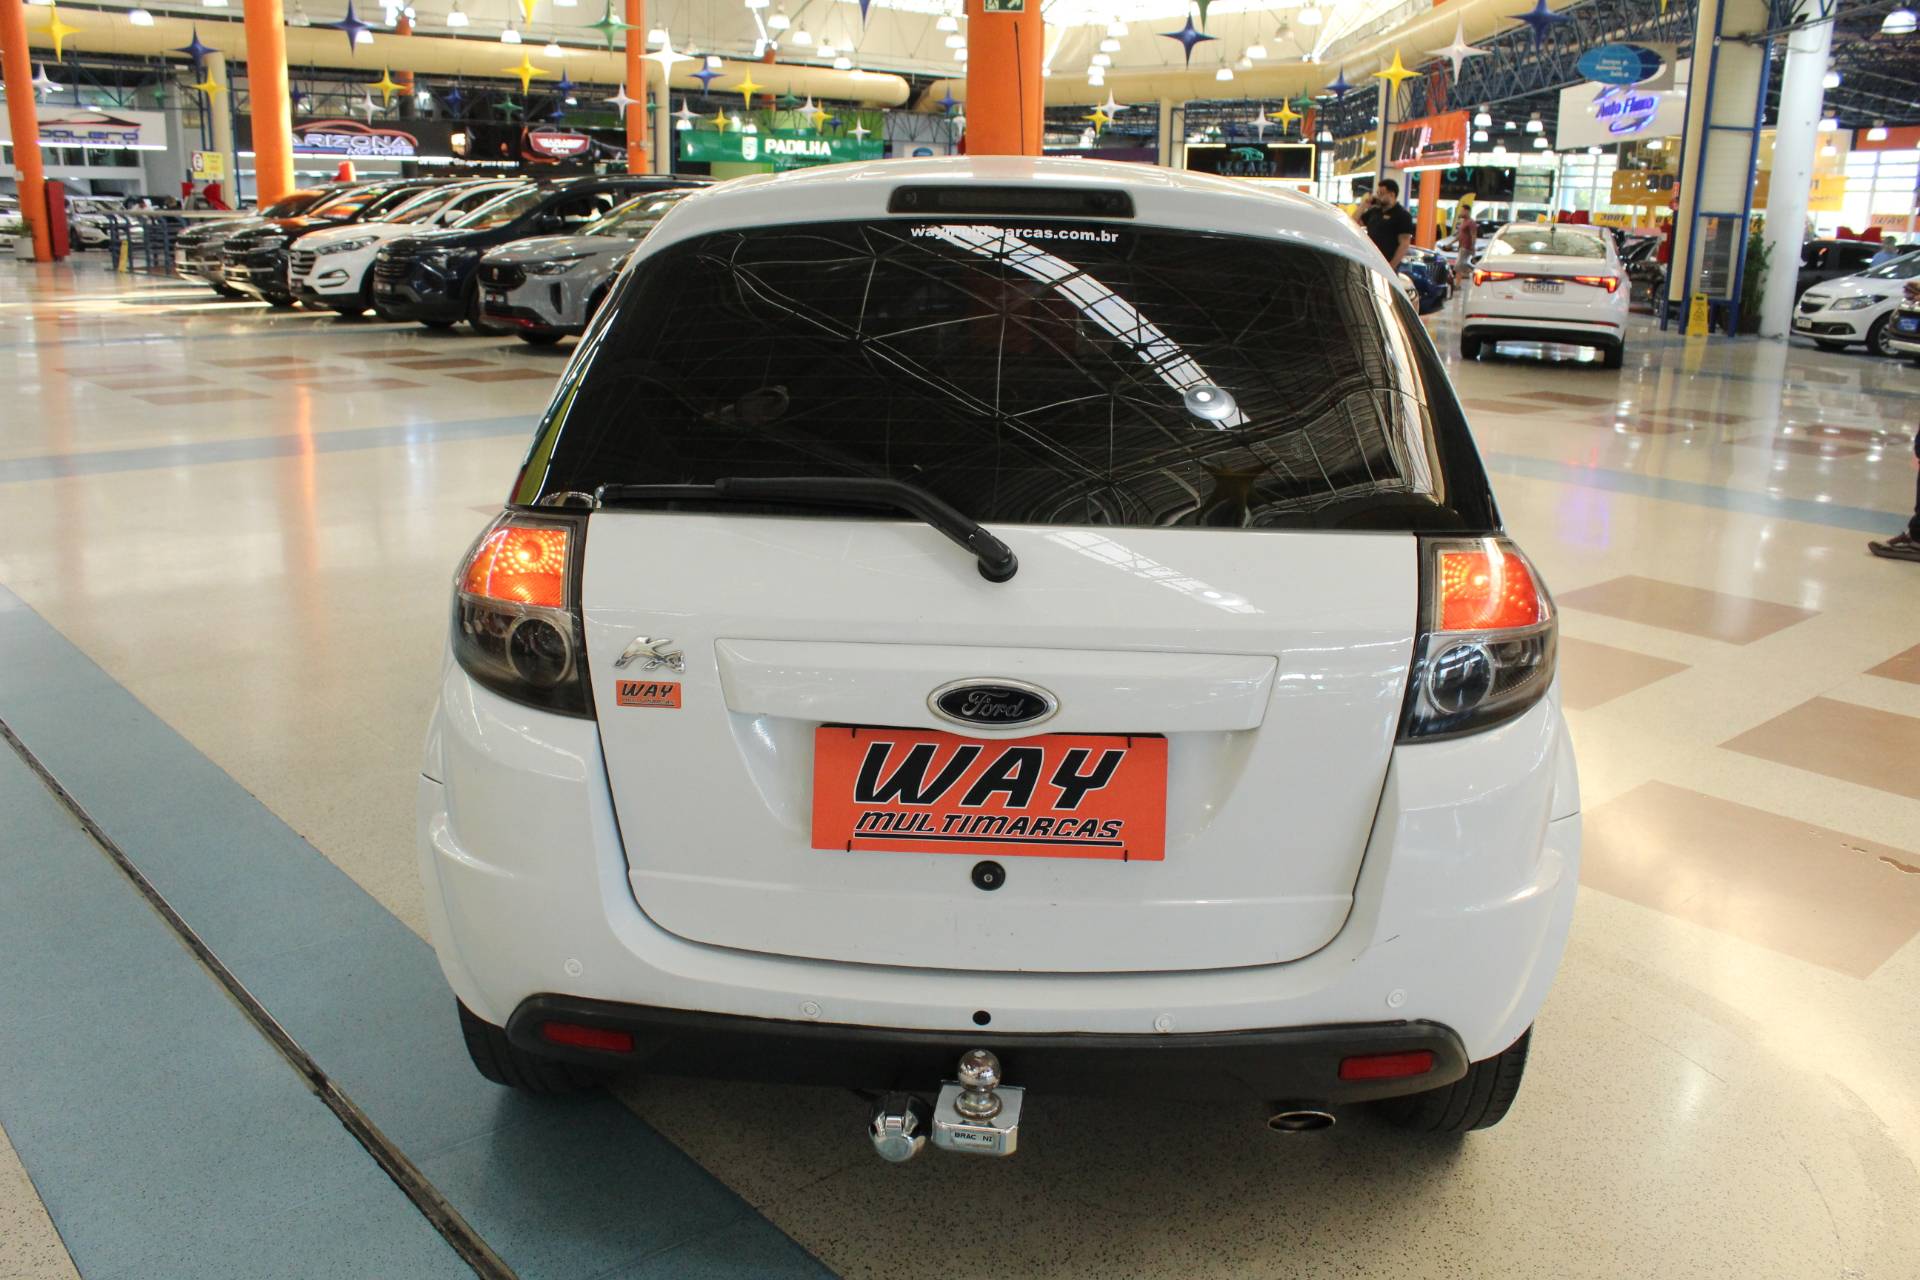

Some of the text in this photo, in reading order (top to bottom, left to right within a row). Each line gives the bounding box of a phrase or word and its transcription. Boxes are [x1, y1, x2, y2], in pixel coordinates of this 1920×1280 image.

[764, 138, 832, 156] PADILHA
[911, 225, 1119, 243] wayarcas.com.br
[622, 684, 674, 697] WAY
[961, 690, 1023, 718] Ford
[853, 741, 1128, 811] WAY
[855, 811, 1124, 839] MULTIMARCAS
